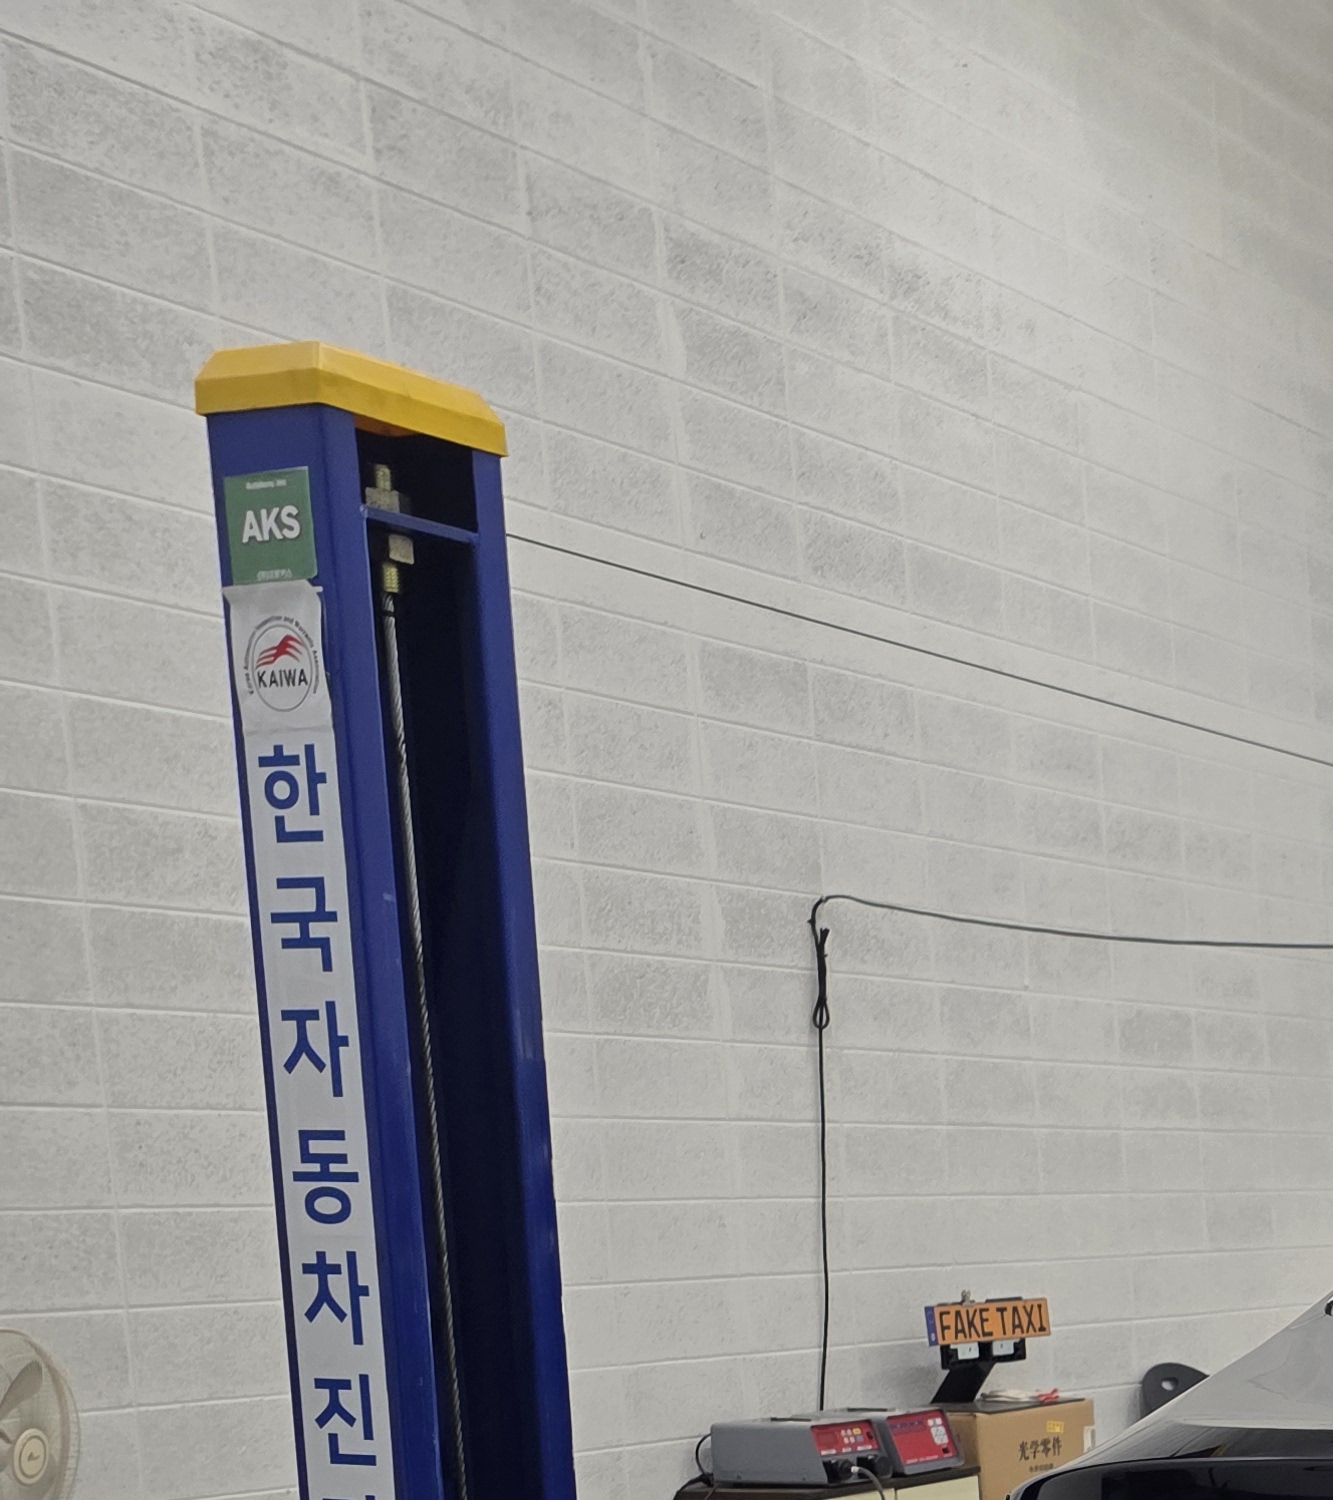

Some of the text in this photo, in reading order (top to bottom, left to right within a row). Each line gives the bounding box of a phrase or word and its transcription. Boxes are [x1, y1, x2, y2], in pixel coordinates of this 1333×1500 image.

[242, 505, 301, 543] AKS
[257, 668, 308, 688] KAIWA
[939, 1303, 1047, 1341] FAKE TAXI
